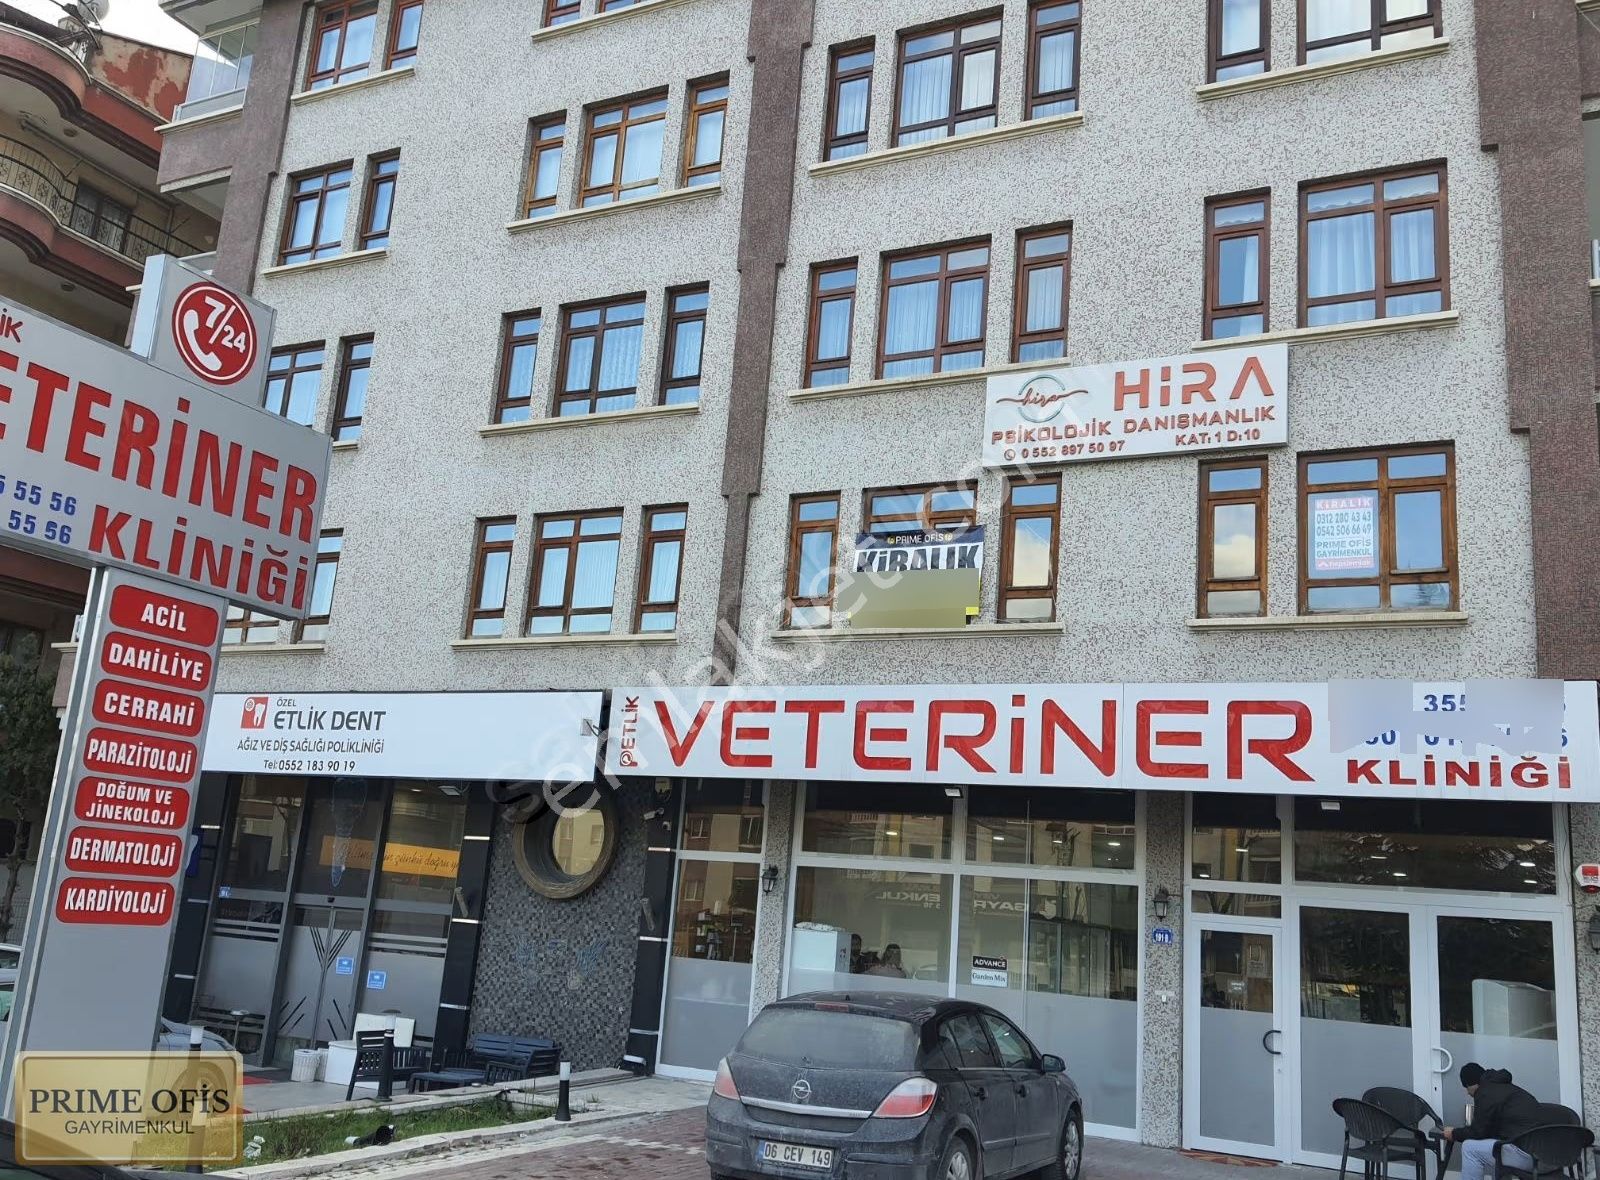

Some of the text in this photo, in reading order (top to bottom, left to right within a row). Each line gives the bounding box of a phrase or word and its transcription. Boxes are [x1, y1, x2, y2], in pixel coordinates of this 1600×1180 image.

[204, 296, 246, 353] 7/24
[992, 418, 1112, 445] PSİKOLOJİK
[1215, 431, 1221, 443] 1
[1022, 440, 1125, 458] 0 552 897 50 97
[14, 480, 42, 506] 55
[49, 491, 77, 516] 56
[8, 509, 72, 545] 55 56
[895, 534, 922, 545] PRIME
[1336, 524, 1350, 536] 506
[88, 505, 308, 610] KLİNİĞİ
[1316, 540, 1347, 549] PRIME
[141, 603, 187, 632] ACİL
[109, 642, 203, 682] DAHİLİYE
[104, 692, 195, 726] CERRAHİ
[276, 698, 297, 707] ÖZEL
[273, 705, 387, 731] ETLİK DENT
[620, 695, 639, 767] PETLİK
[237, 738, 385, 755] AĞIZ VE DİŞ SAĞLIĞI POLİKLİNİĞİ
[654, 695, 1315, 782] VETERİNER
[87, 738, 192, 774] PARAZİTOLOJİ
[306, 760, 324, 771] 183
[328, 760, 341, 772] 90
[343, 761, 355, 772] 19
[1347, 754, 1571, 789] KLİNİĞİ
[96, 781, 173, 804] DOĞUM VE
[70, 837, 177, 868] DERMATOLOJİ
[65, 885, 167, 914] KARDİYOLOJİ
[974, 958, 1006, 968] ADVANCE
[764, 1143, 830, 1166] 06 CEV 149
